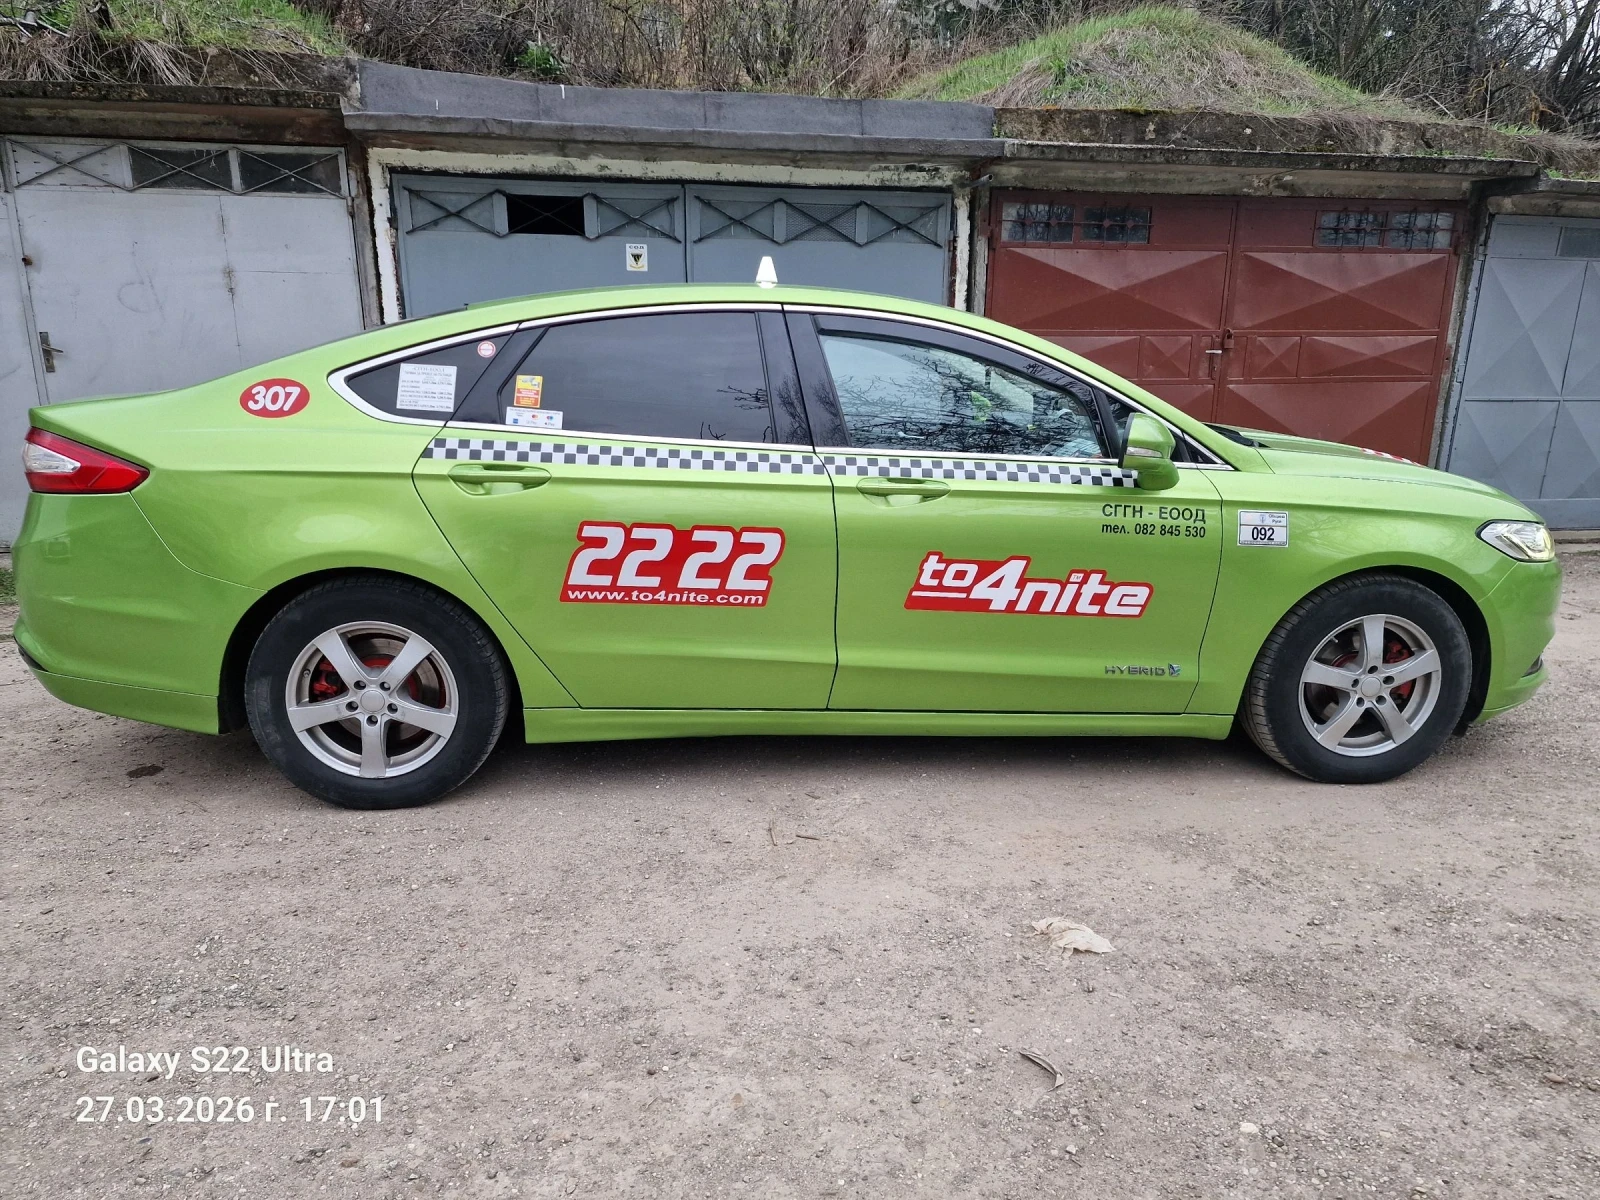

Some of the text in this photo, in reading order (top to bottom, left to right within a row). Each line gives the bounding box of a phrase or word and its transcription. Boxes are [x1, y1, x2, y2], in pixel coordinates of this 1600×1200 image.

[247, 385, 301, 412] 307
[1102, 503, 1143, 519] СГГН
[1158, 506, 1206, 524] ЕООД
[1101, 523, 1206, 538] тел. 082 845 530
[1251, 526, 1275, 541] 092
[567, 525, 782, 591] 22 22
[919, 554, 1151, 616] to4nite
[567, 589, 764, 604] www.to4nite.com
[1104, 665, 1166, 677] HYBRID
